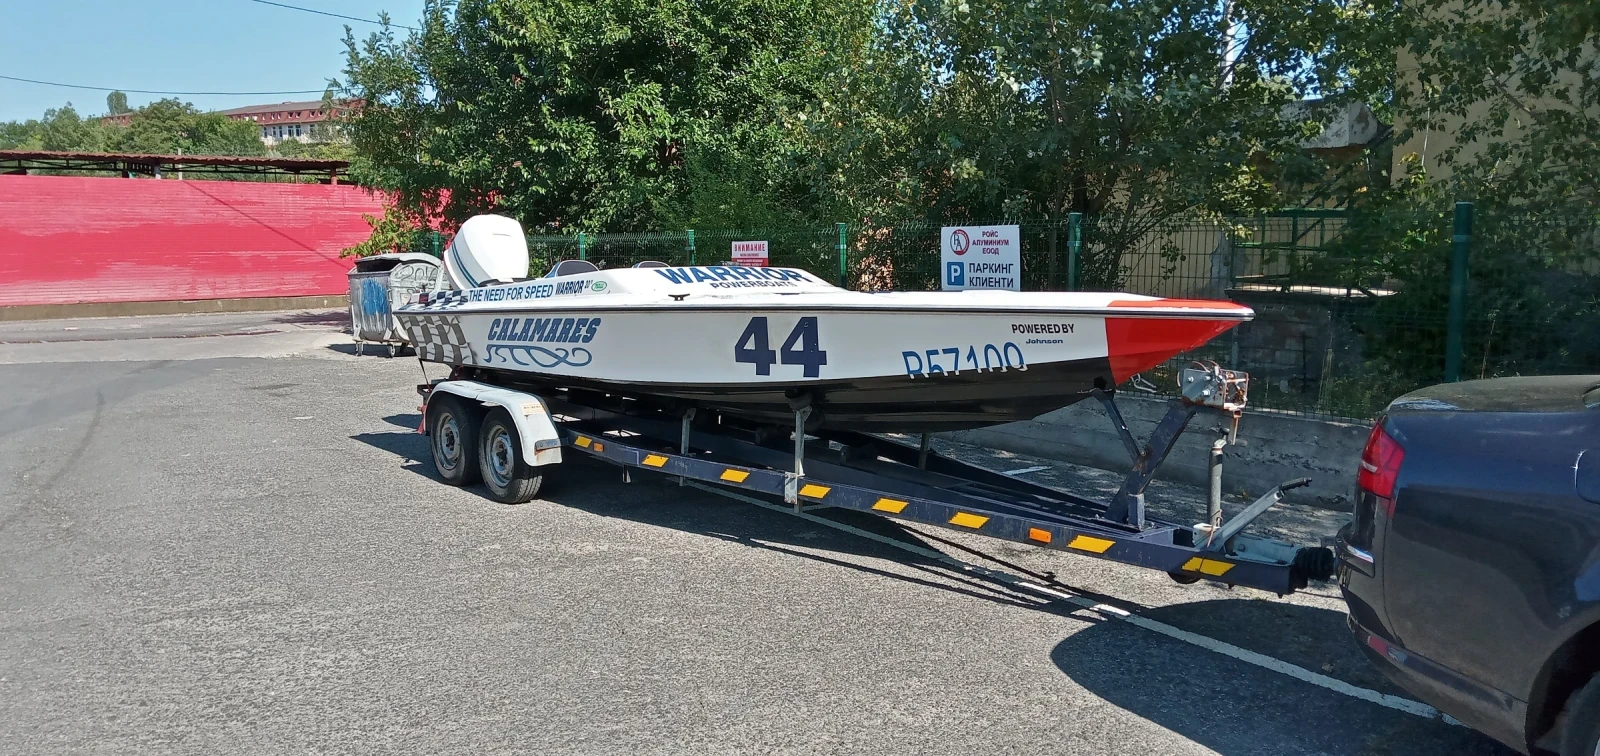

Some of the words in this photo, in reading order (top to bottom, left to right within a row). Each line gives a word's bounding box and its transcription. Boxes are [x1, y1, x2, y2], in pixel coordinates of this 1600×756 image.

[982, 230, 999, 238] РОЙС
[734, 243, 766, 252] ВНИМАНИЕ
[982, 247, 1000, 255] ЕООД
[969, 263, 1014, 275] ПАРКИНГ
[654, 266, 814, 285] WARRIOR
[555, 280, 584, 295] WARRIOR
[709, 281, 798, 289] POWERBOATS
[969, 276, 1014, 288] КЛИЕНТИ
[468, 290, 482, 302] THE
[484, 288, 505, 301] NEED
[506, 286, 522, 300] FOR
[524, 284, 554, 299] SPEED
[487, 318, 602, 343] CALAMARES
[1011, 323, 1061, 334] POWERED
[1062, 323, 1075, 333] BY
[734, 316, 828, 378] 44
